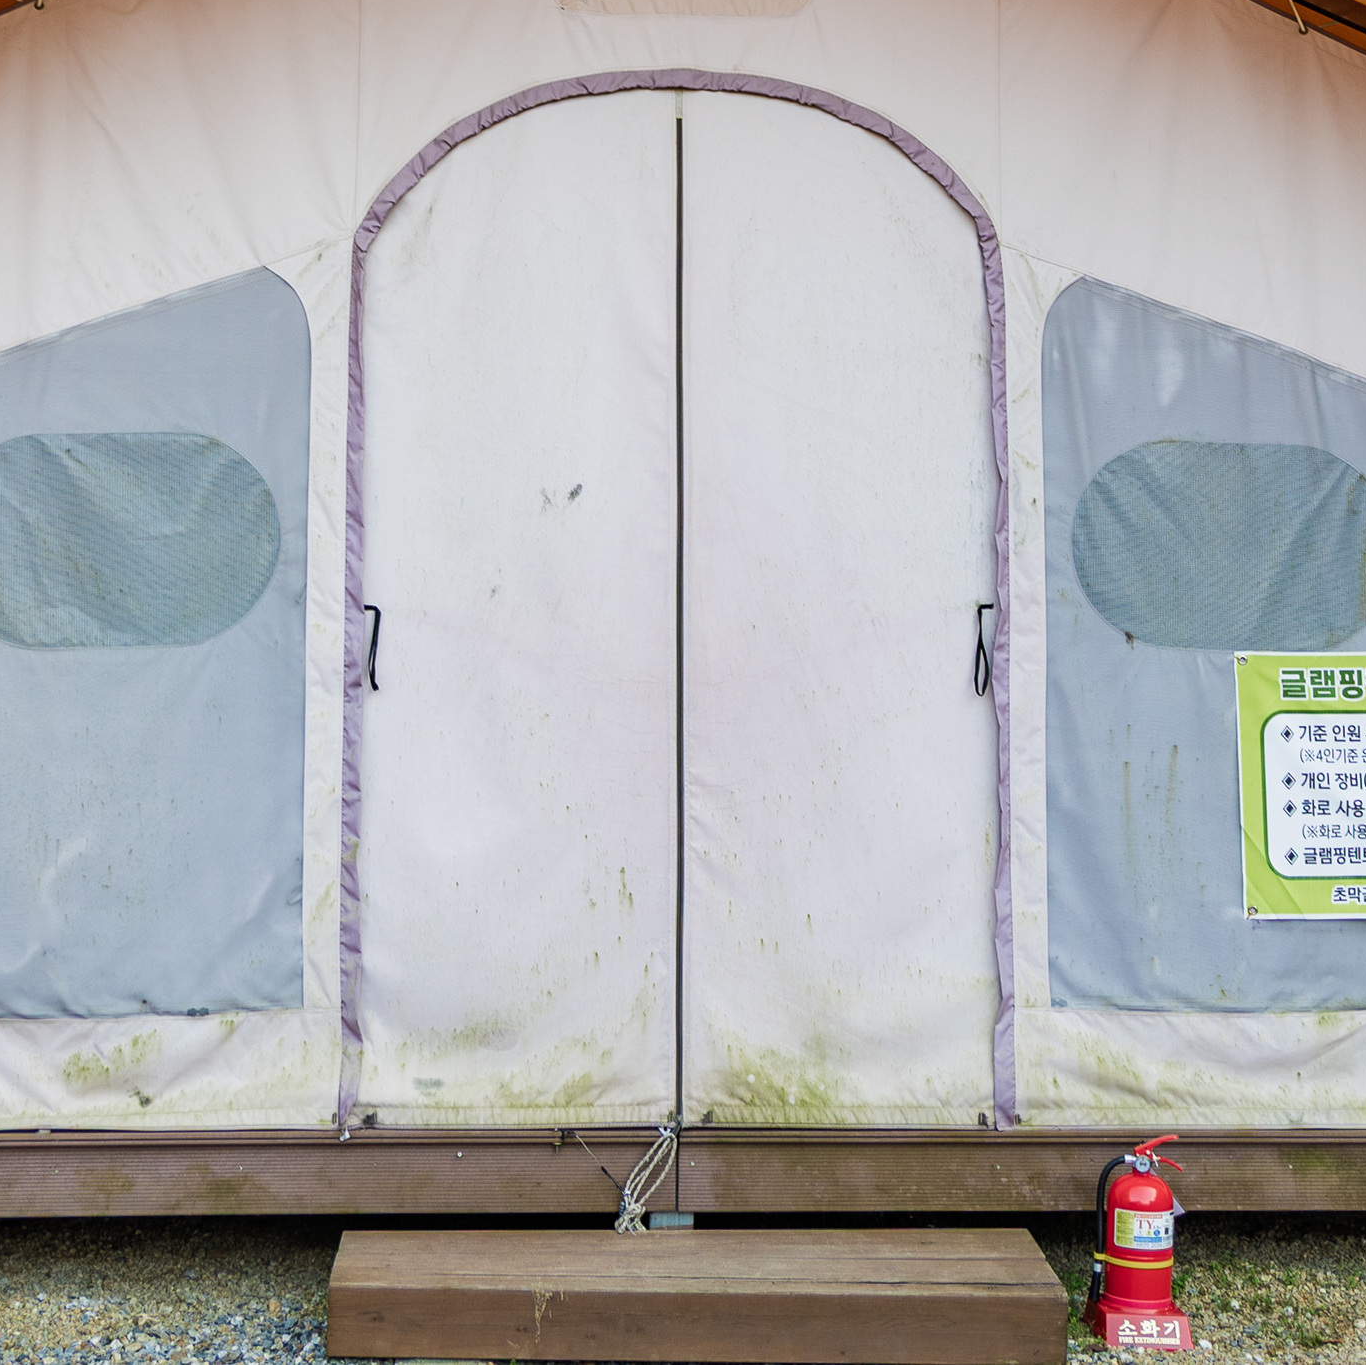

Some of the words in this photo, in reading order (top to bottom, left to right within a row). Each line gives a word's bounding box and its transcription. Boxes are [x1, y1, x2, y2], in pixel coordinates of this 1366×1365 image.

[1298, 724, 1328, 742] 기준
[1332, 724, 1361, 742] 인원
[1301, 772, 1331, 790] 개인
[1301, 799, 1331, 817] 화로
[1335, 799, 1366, 818] 사용
[1117, 1319, 1181, 1339] 소화기
